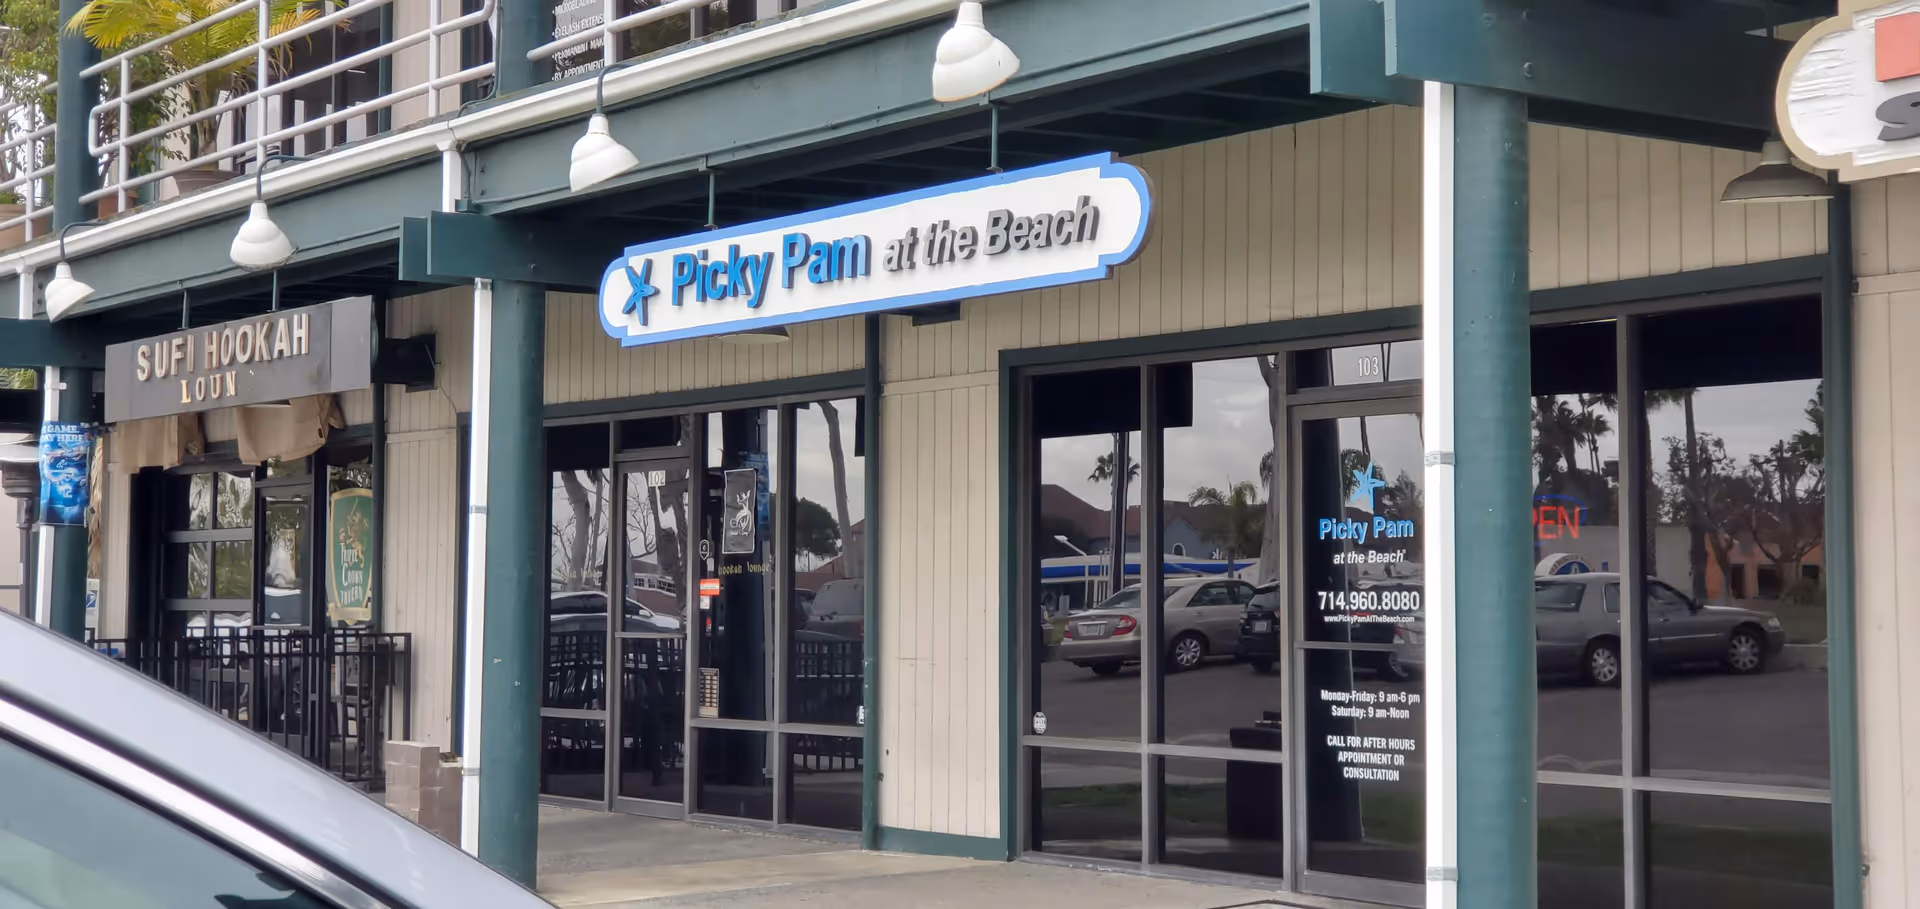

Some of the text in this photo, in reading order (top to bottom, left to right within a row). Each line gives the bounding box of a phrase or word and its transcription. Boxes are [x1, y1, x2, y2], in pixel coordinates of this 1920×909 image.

[555, 70, 563, 80] BY
[671, 195, 1098, 309] Picky Pam at the Beach
[136, 313, 310, 382] SUFI HOOKAH
[1358, 356, 1379, 377] 103
[180, 371, 238, 404] LOUN
[650, 471, 665, 485] 102
[1319, 516, 1414, 544] Picky Pam
[1333, 551, 1345, 565] at
[1347, 550, 1365, 564] the
[1317, 591, 1420, 610] 714.960.8080
[1321, 689, 1377, 704] Monday-Friday:
[1379, 691, 1385, 703] 9
[1408, 693, 1421, 706] pm
[1331, 705, 1367, 720] Saturday:
[1368, 706, 1374, 718] 9
[1327, 735, 1416, 751] CALL FOR AFTER HOURS
[1338, 751, 1405, 766] APPOINTMENT OR
[1343, 767, 1400, 781] CONSULTATION
